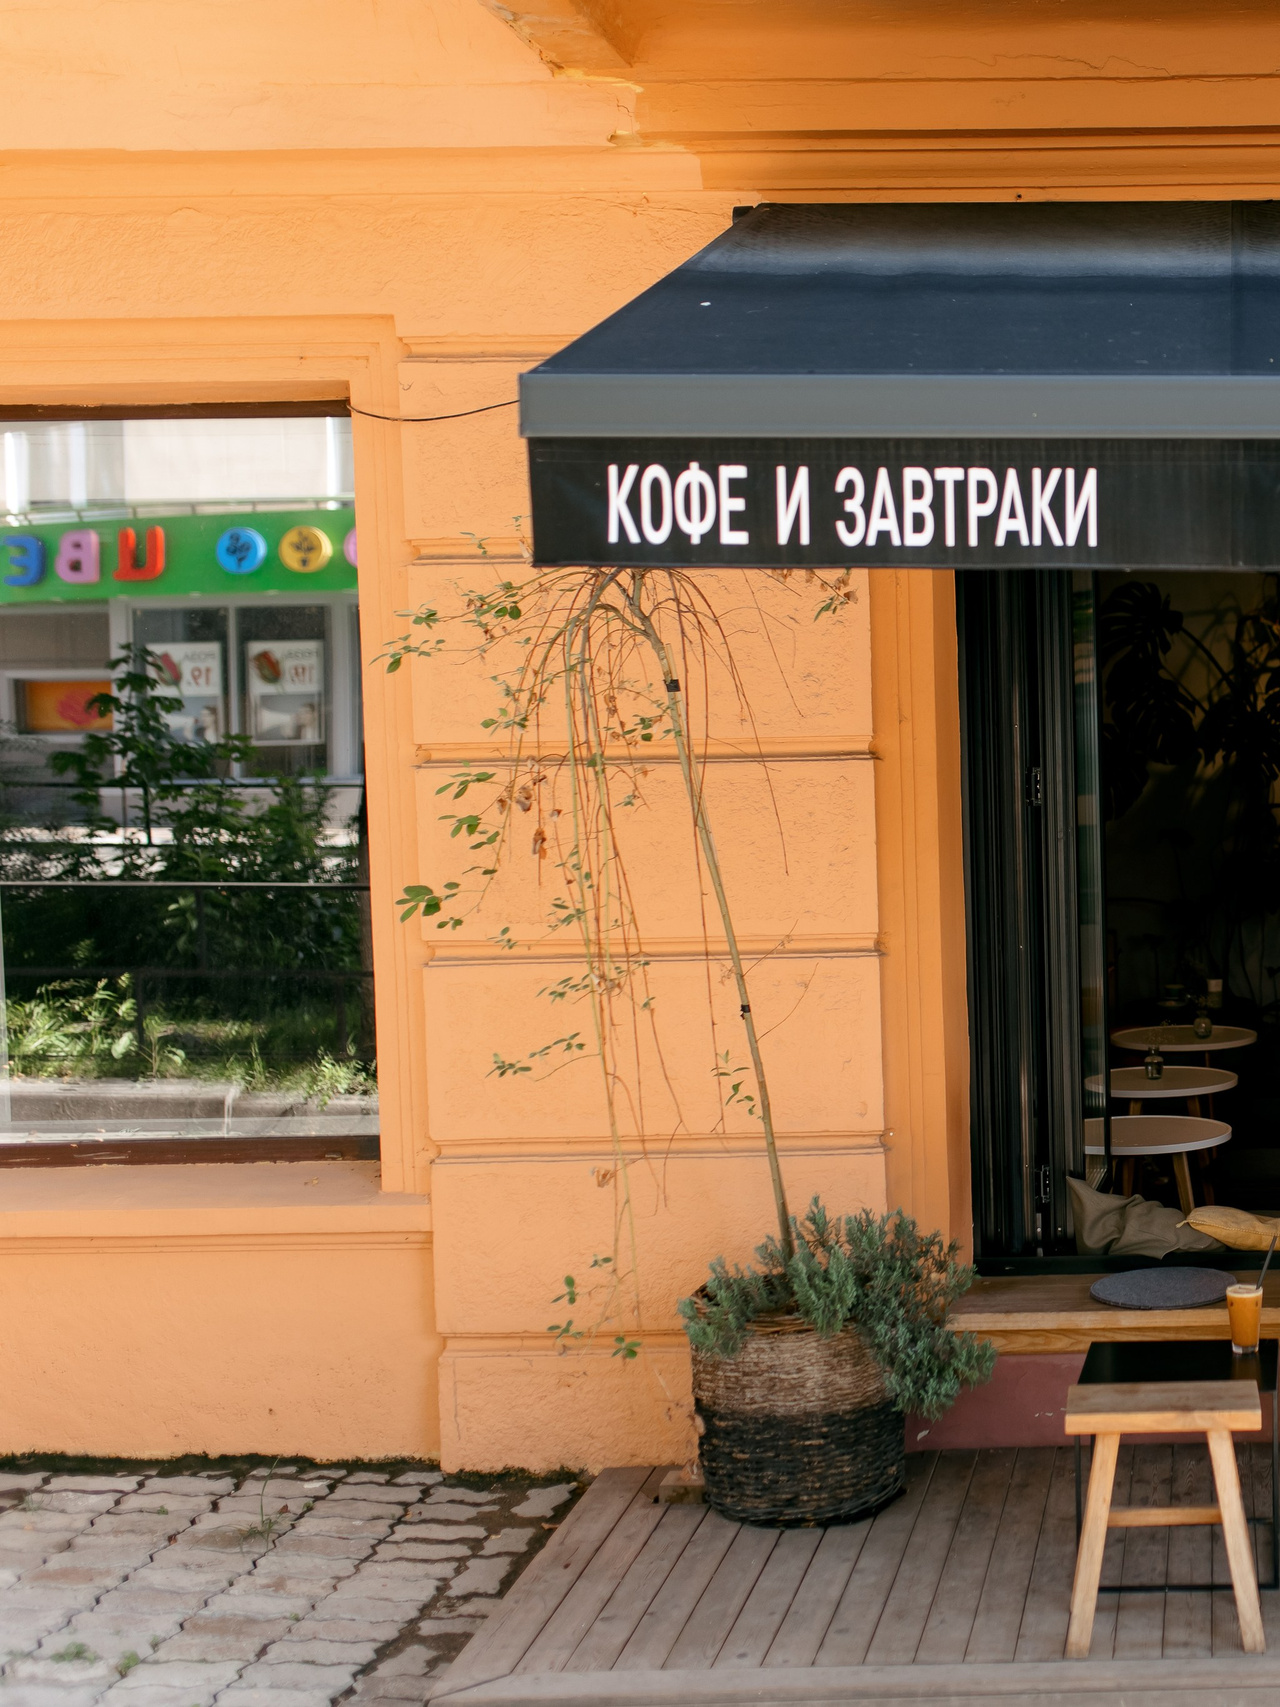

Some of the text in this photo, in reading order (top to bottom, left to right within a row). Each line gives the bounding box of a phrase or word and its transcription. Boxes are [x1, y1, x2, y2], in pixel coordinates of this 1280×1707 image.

[607, 461, 1099, 549] КОФЕ И ЗАВТРАКИ
